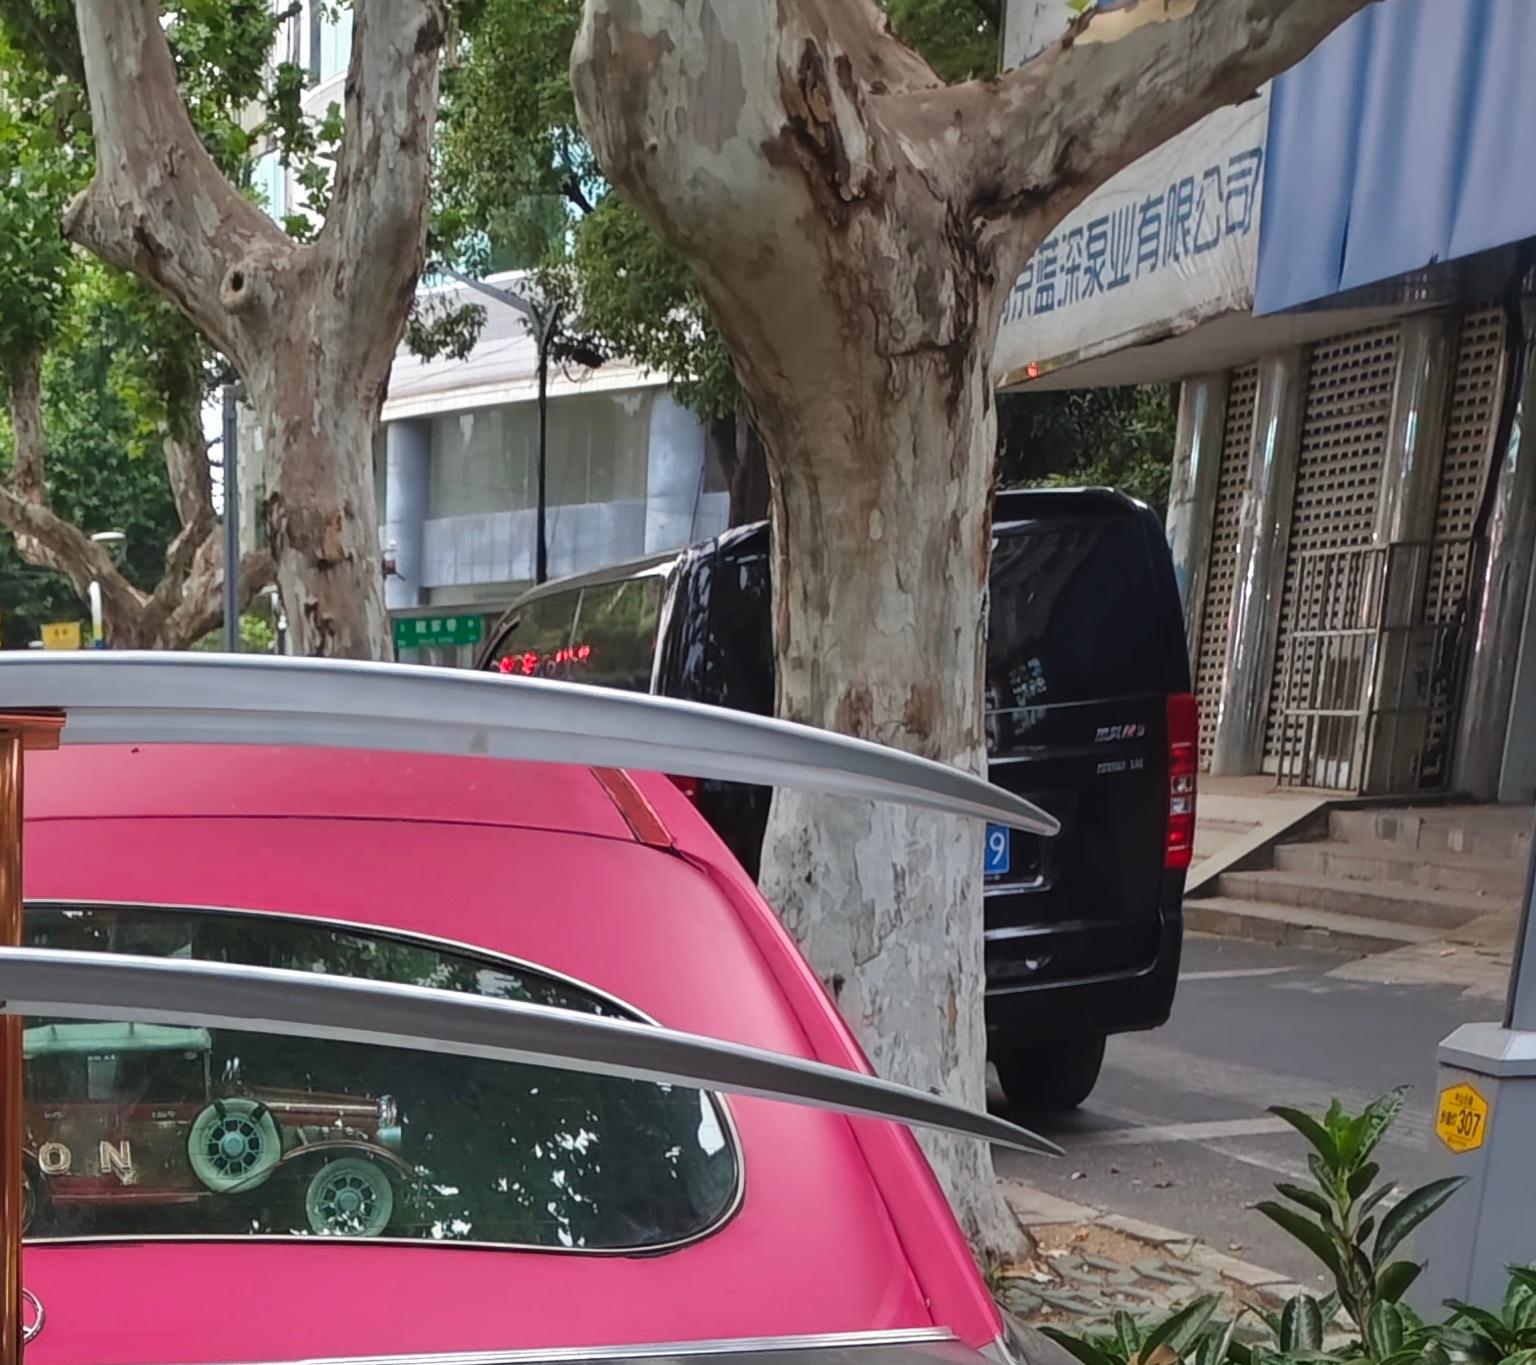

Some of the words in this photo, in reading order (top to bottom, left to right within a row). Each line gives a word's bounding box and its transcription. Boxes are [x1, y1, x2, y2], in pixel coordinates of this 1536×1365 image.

[1003, 147, 1264, 326] 京蓝深泵业有限公司
